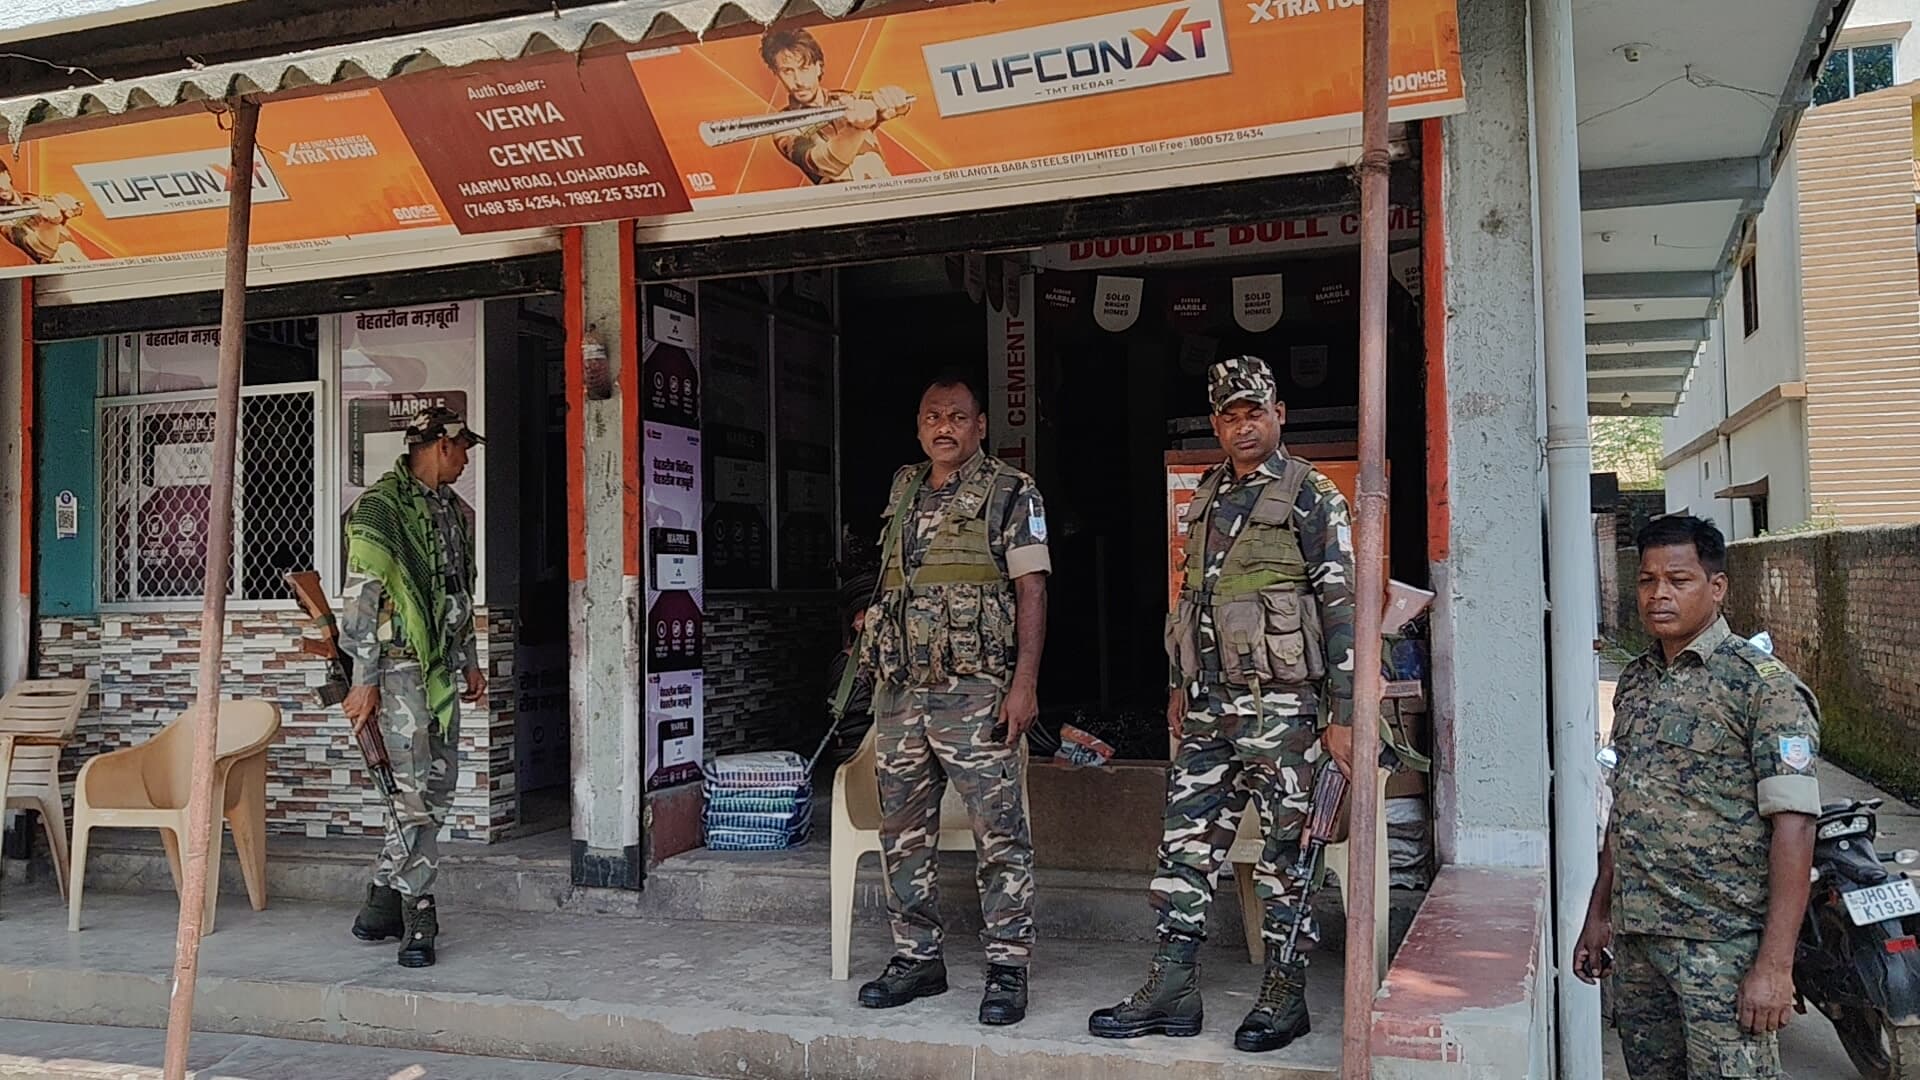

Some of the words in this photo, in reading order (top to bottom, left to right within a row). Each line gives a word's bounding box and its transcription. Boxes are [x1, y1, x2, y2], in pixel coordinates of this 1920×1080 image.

[940, 7, 1212, 98] TUFCONXT
[467, 84, 499, 102] Auth
[499, 78, 546, 97] Dealer:
[1044, 84, 1069, 96] TMT
[1072, 78, 1114, 92] REBAR
[476, 101, 566, 132] VERMA
[279, 142, 330, 166] XTRA
[327, 142, 378, 161] TOUGH
[489, 135, 586, 168] CEMENT
[943, 171, 959, 181] SRI
[1001, 161, 1029, 174] BABA
[1031, 155, 1070, 169] STEELS
[1087, 147, 1129, 161] LIMITED
[1139, 143, 1158, 155] Toll
[1189, 134, 1213, 147] 1800
[1215, 131, 1234, 144] 572
[1236, 127, 1264, 141] 8434
[458, 180, 511, 197] HARMU
[512, 175, 557, 192] ROAD,
[557, 162, 650, 186] LOHARDAGA
[464, 200, 505, 219] (7488
[507, 198, 525, 214] 35
[526, 194, 565, 212] 4254,
[602, 188, 622, 203] 25
[624, 182, 667, 200] 3327)
[1104, 301, 1129, 309] BRIGHT
[1105, 293, 1131, 301] SOLID
[1173, 303, 1207, 312] MARBLE
[1244, 292, 1271, 301] SOLID
[1244, 300, 1271, 308] BRIGHT
[1103, 308, 1129, 316] HOMES
[1244, 308, 1271, 316] HOMES
[1006, 317, 1026, 427] CEMENT
[1860, 883, 1908, 905] JH01E
[1863, 897, 1915, 920] K1933
